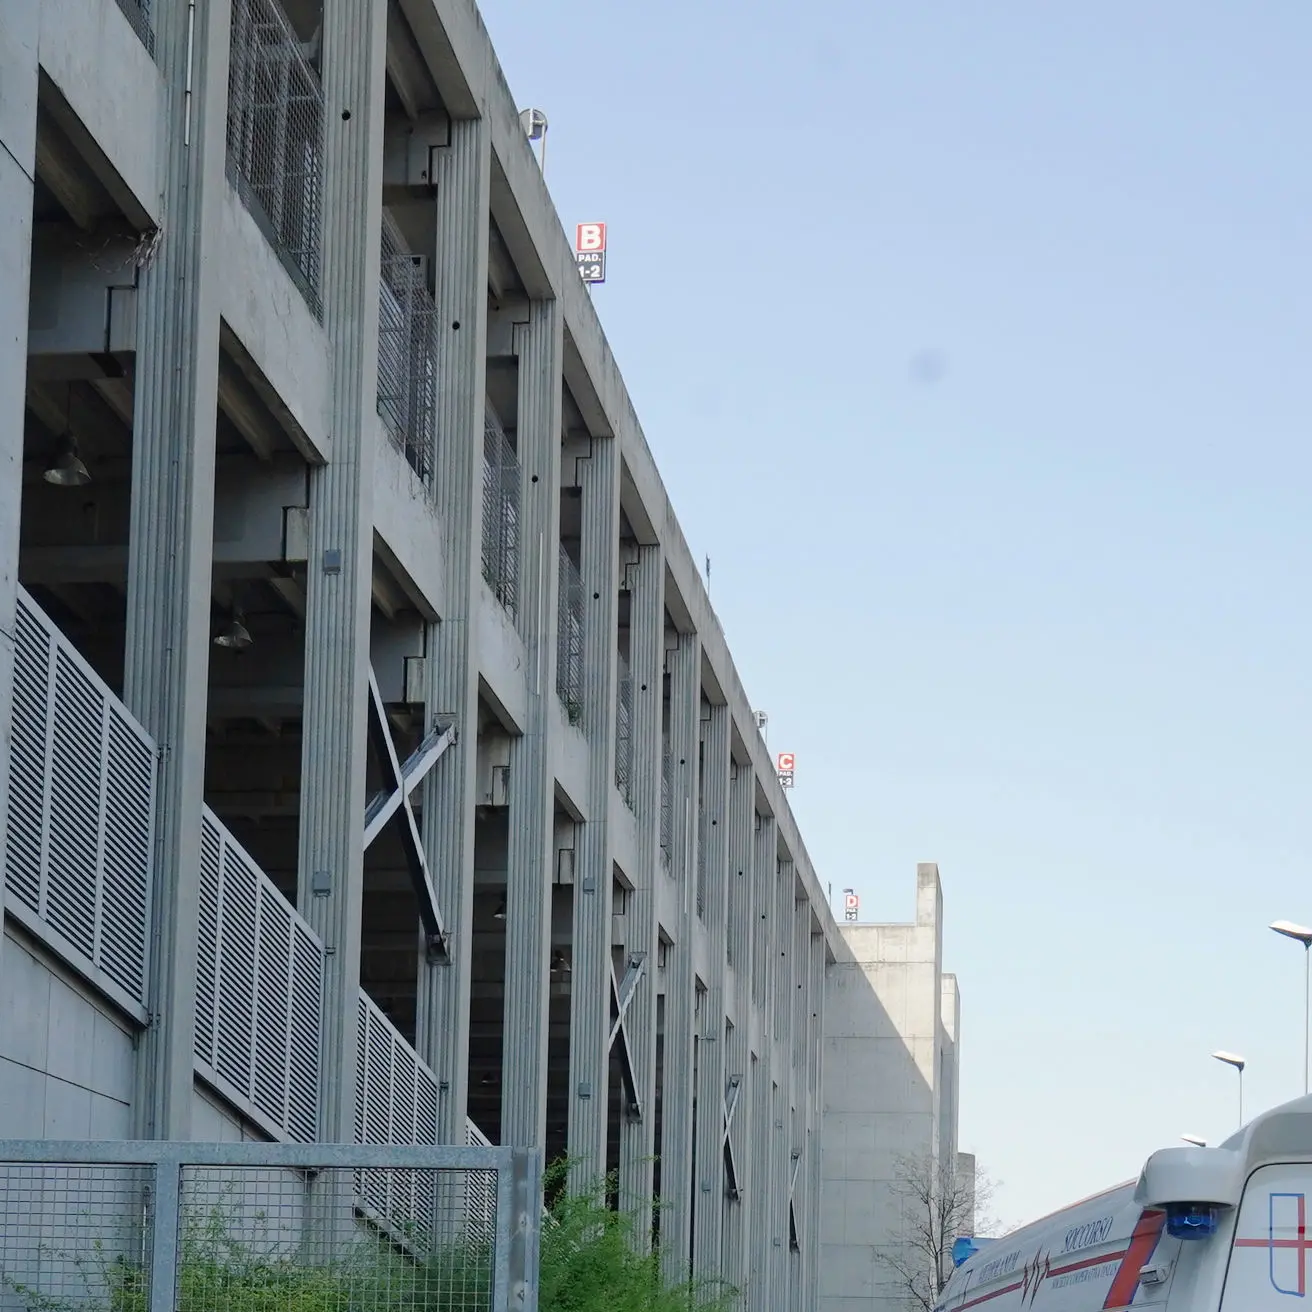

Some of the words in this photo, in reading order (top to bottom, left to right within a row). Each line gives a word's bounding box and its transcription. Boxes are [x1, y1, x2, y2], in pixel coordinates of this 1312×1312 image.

[581, 224, 602, 250] B
[578, 253, 602, 262] PAD.
[578, 265, 601, 278] 1-2
[779, 754, 794, 769] C
[846, 895, 858, 907] D
